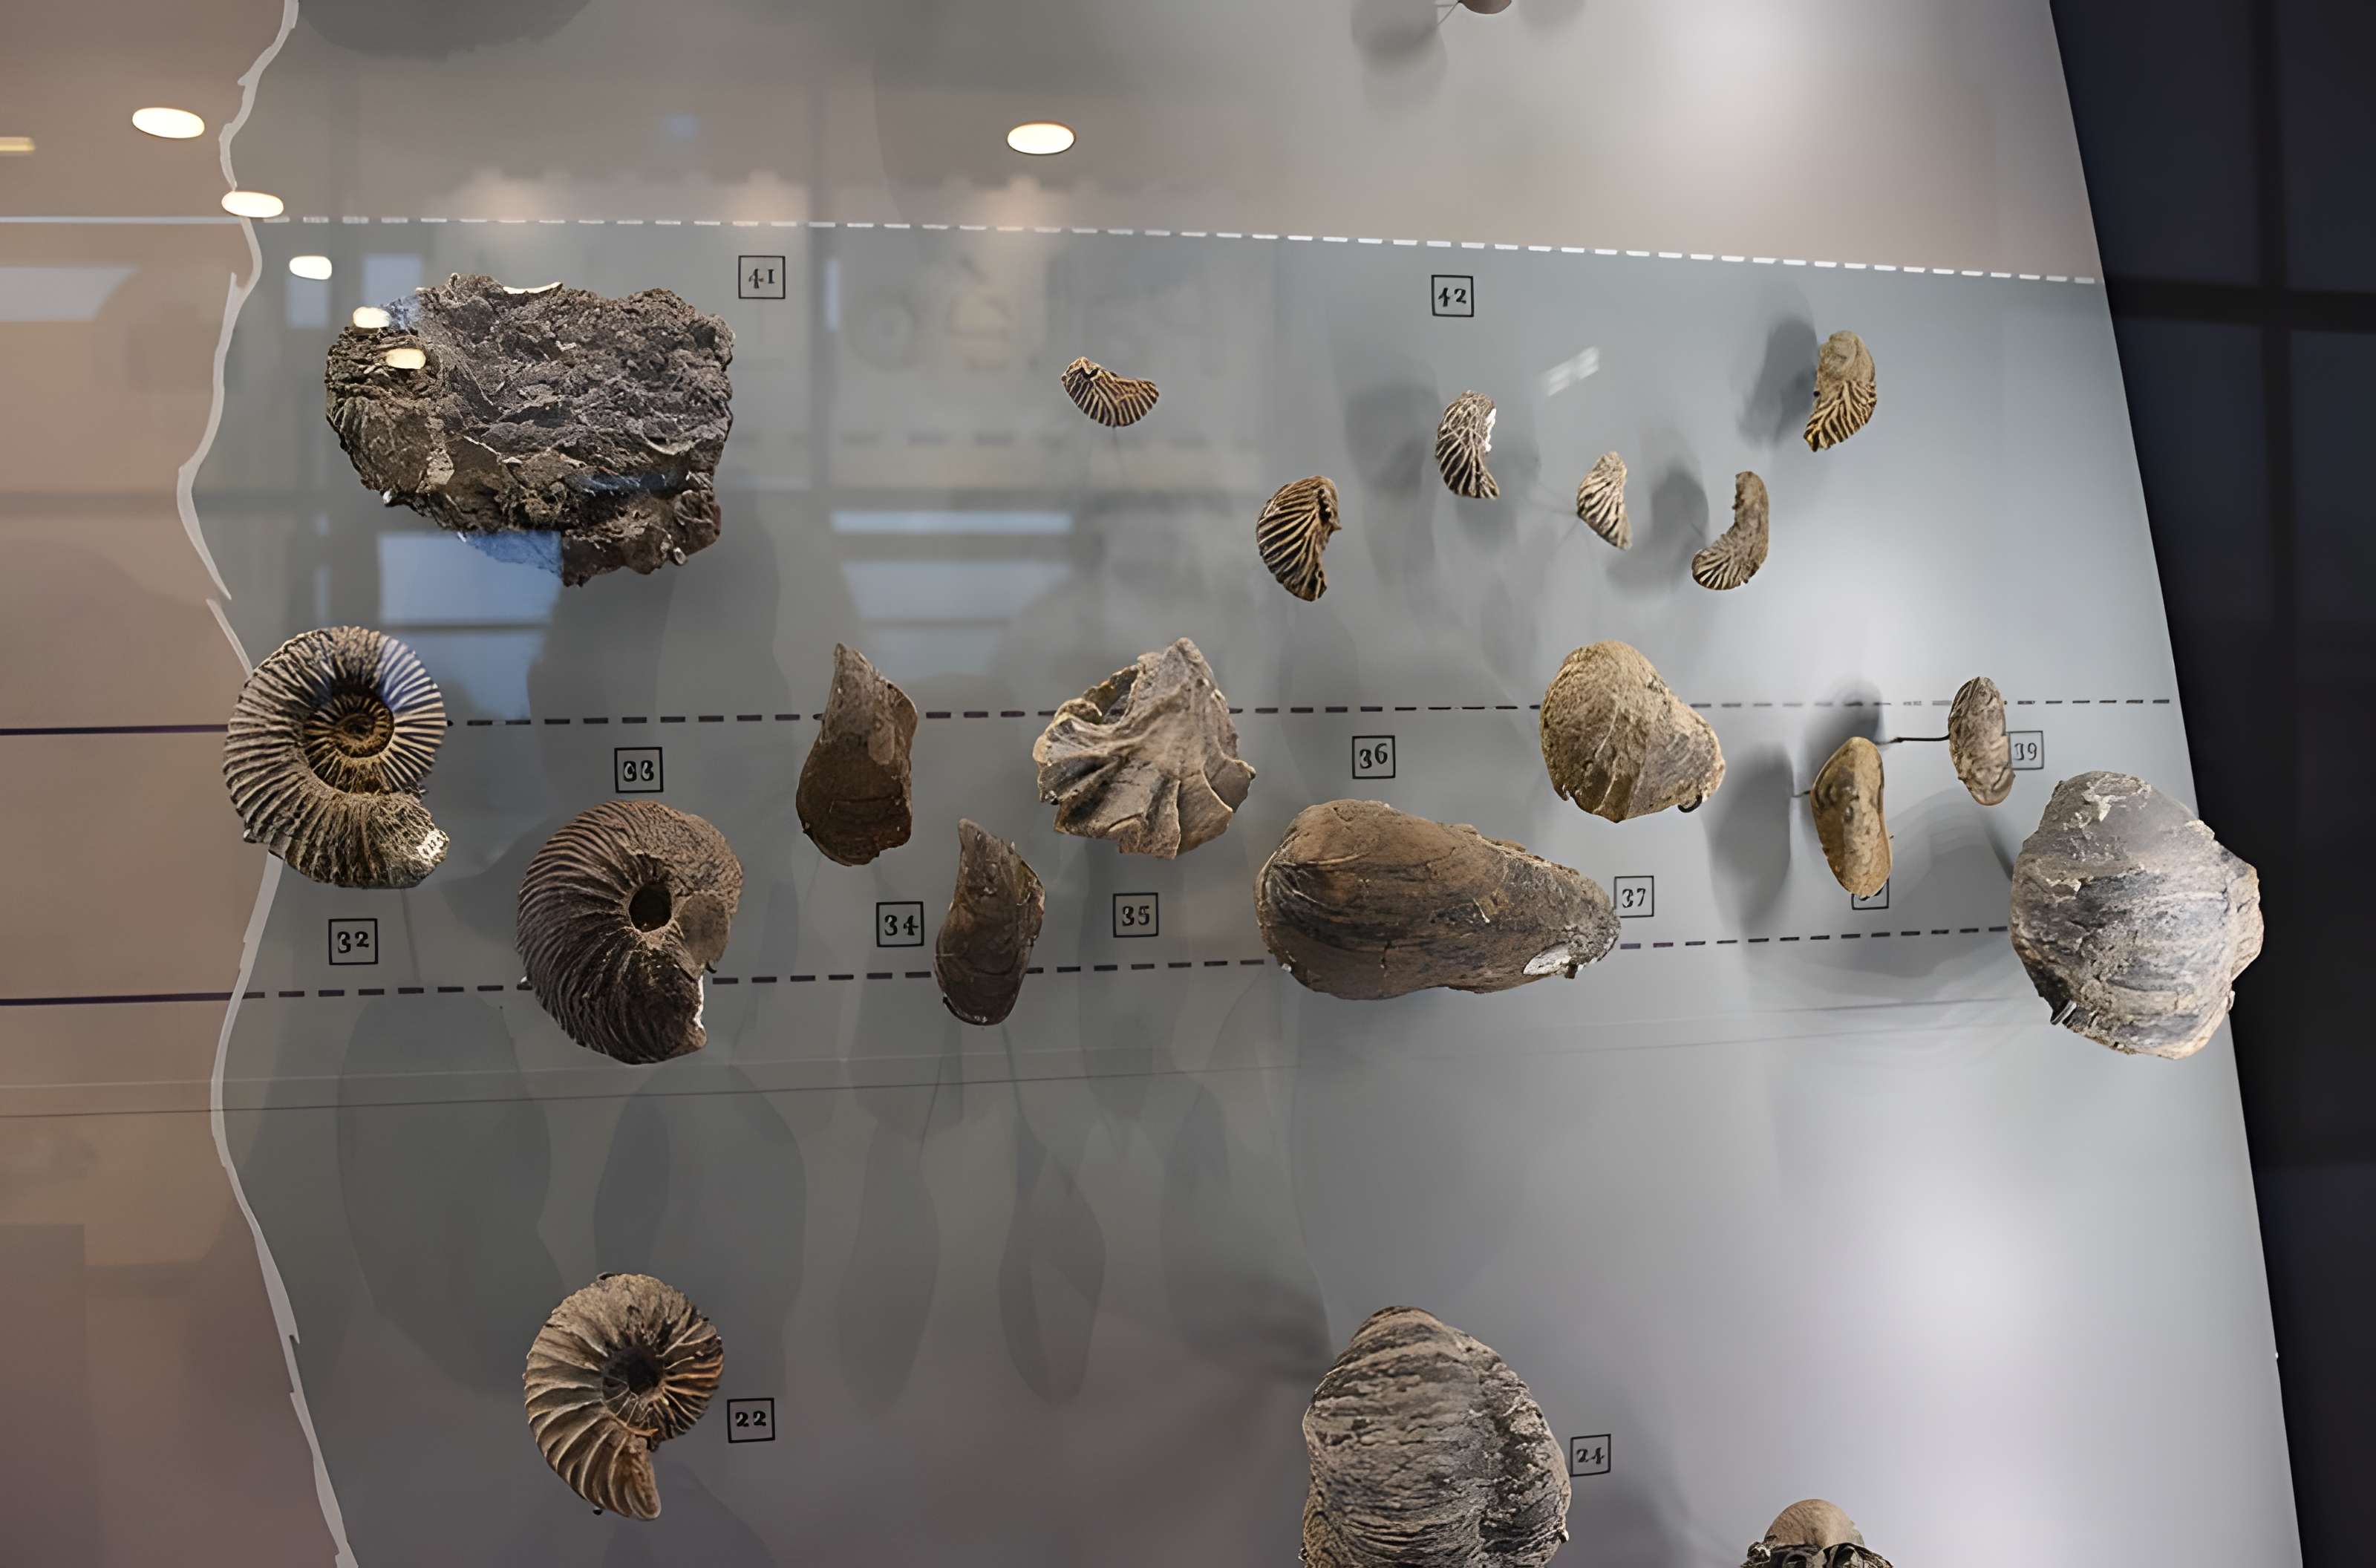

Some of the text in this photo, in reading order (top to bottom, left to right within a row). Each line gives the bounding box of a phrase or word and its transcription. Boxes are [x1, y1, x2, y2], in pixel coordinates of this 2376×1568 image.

[748, 269, 774, 289] 41
[1438, 287, 1466, 307] 42
[1360, 743, 1388, 769] 36
[624, 760, 654, 782] 33
[1622, 888, 1645, 908] 37
[884, 915, 918, 935] 34
[1122, 906, 1150, 927] 35
[337, 932, 369, 954] 32
[736, 1411, 766, 1427] 22
[1576, 1447, 1605, 1464] 24
